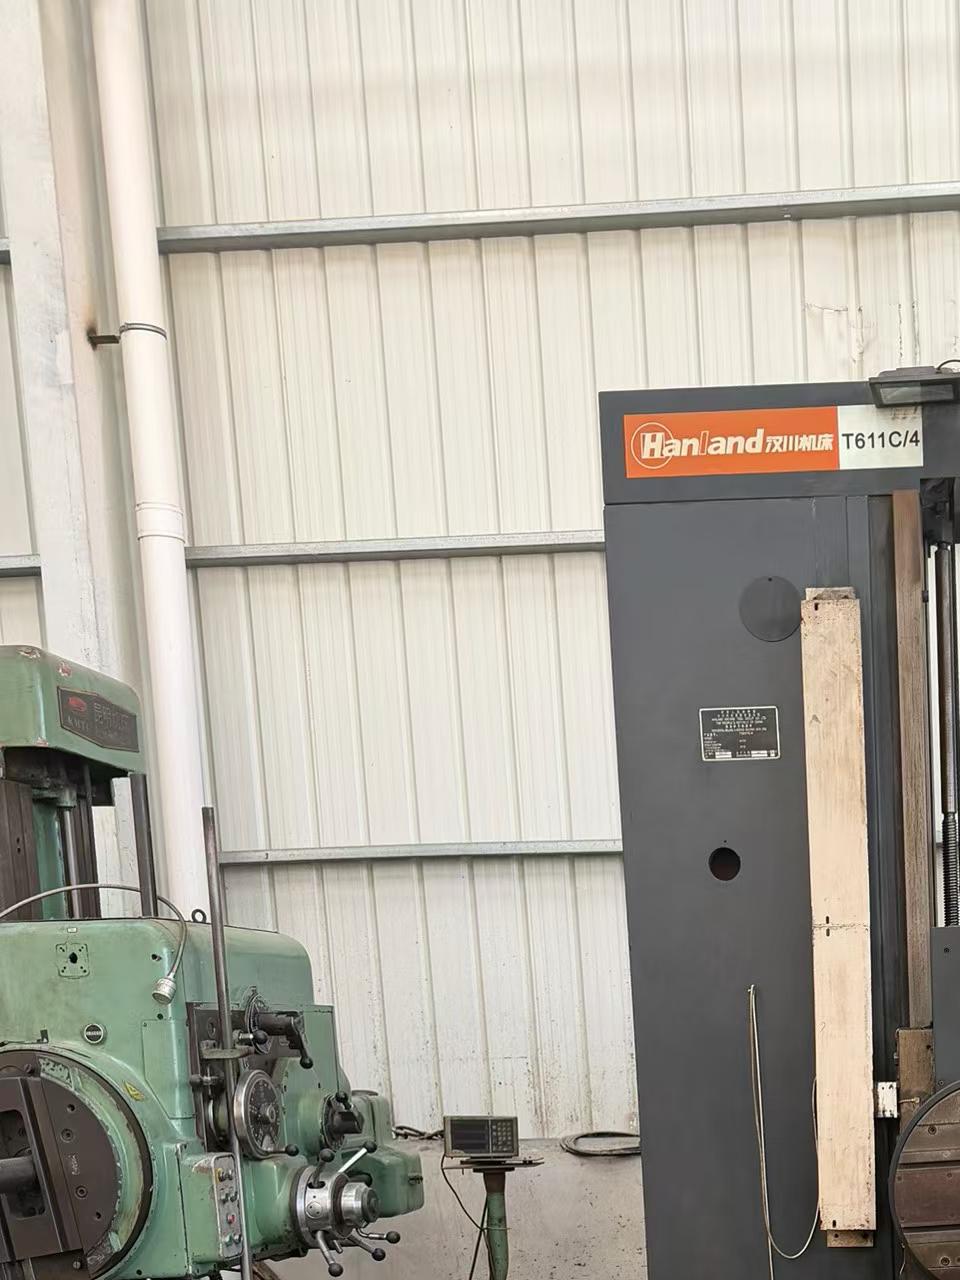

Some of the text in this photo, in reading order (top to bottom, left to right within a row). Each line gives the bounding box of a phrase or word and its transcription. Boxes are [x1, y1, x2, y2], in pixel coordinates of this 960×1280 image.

[640, 428, 765, 459] Hanland
[765, 433, 834, 453] 汉川机床
[841, 430, 920, 450] T611C/4
